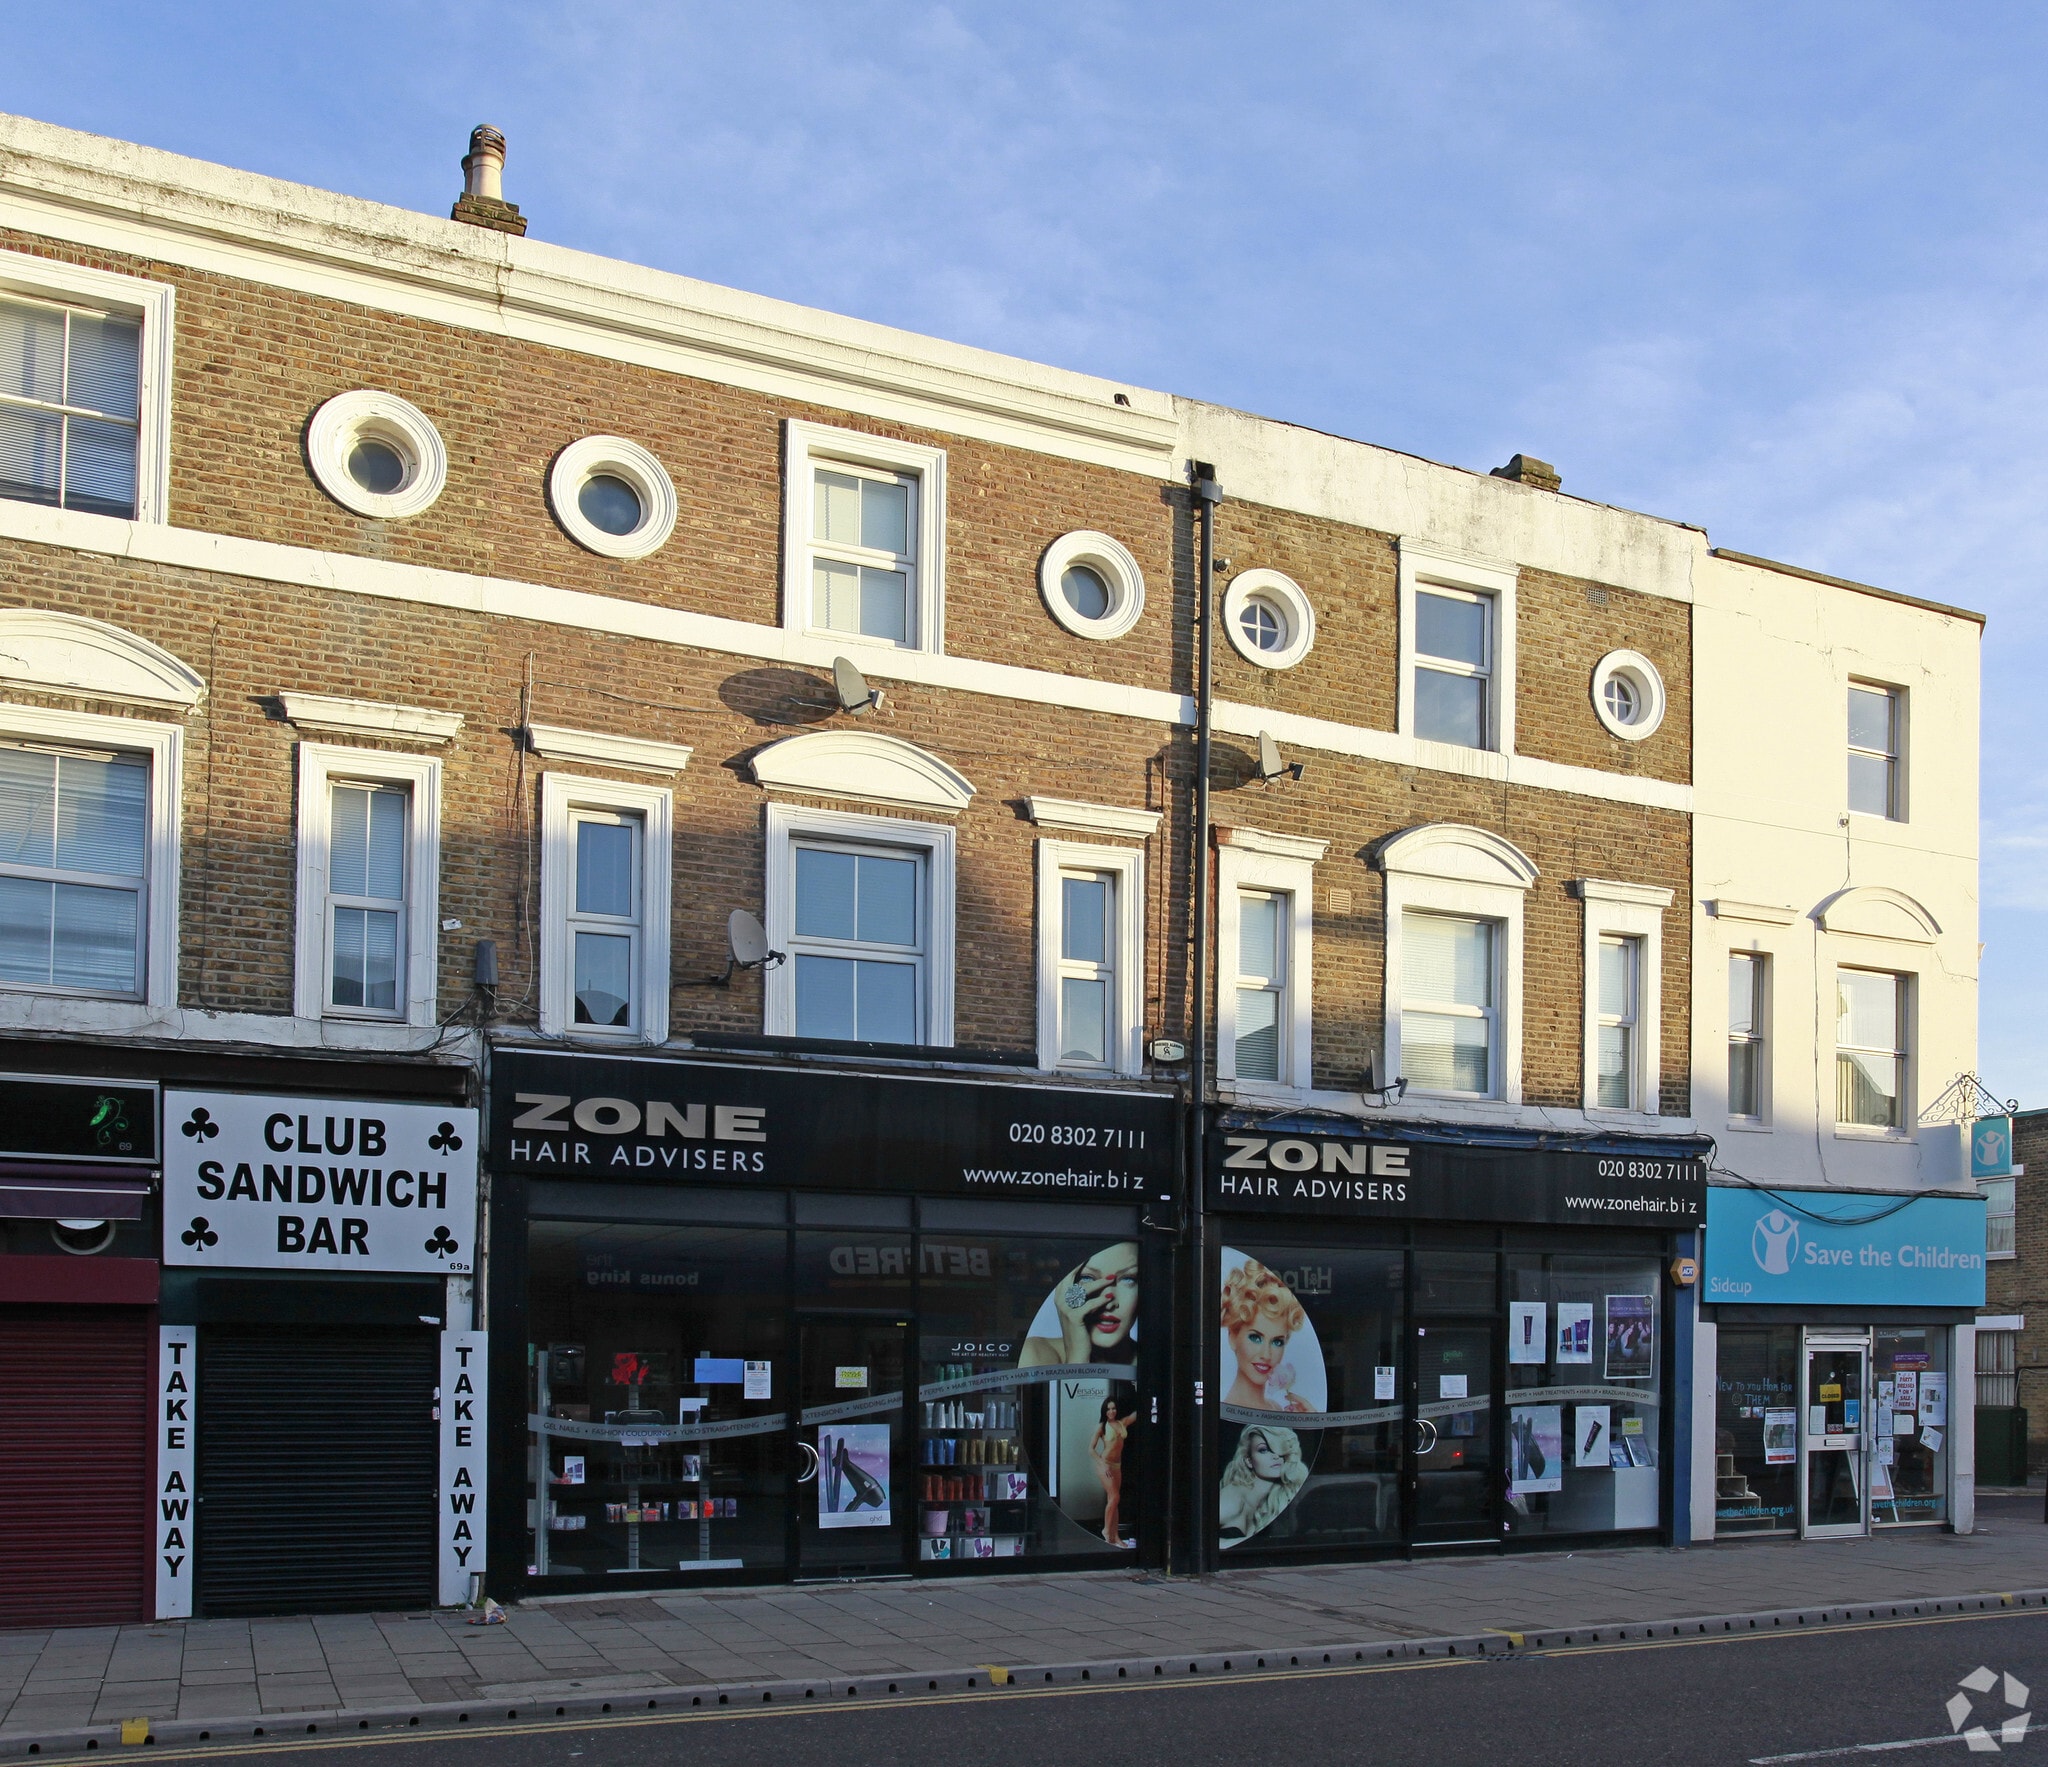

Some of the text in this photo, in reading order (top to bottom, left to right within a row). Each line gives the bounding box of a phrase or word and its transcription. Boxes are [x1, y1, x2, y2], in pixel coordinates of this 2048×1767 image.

[512, 1093, 767, 1142] ZONE
[119, 1142, 132, 1151] 69
[264, 1113, 387, 1156] CLUB
[1009, 1123, 1145, 1149] 020 8302 7111
[511, 1139, 766, 1173] HAIR ADVISERS
[1222, 1136, 1411, 1176] ZONE
[962, 1168, 1144, 1190] www.zonehair.biz
[1599, 1160, 1698, 1181] 020 8302 7111
[197, 1161, 447, 1209] SANDWICH
[1221, 1175, 1408, 1202] HAIR ADVISERS
[1564, 1193, 1698, 1214] www.zonehair.biz
[278, 1216, 370, 1256] BAR
[449, 1262, 470, 1271] 69a
[1804, 1241, 1982, 1270] Save the Children
[1711, 1276, 1753, 1298] Sidcup
[951, 1342, 1010, 1352] JOICO
[924, 1386, 945, 1395] PERMS
[951, 1381, 967, 1390] HAIR
[968, 1375, 1009, 1387] TREATMENTS
[1014, 1371, 1030, 1379] HAIR
[1031, 1370, 1040, 1378] UP
[1045, 1368, 1077, 1376] BRAZILIAN
[165, 1343, 187, 1449] TAKE
[453, 1347, 473, 1446] TAKE
[852, 1398, 887, 1410] WEDDING
[1225, 1407, 1236, 1415] GEL
[1261, 1413, 1286, 1421] FASHION
[1286, 1415, 1320, 1423] COLOURING
[1342, 1411, 1385, 1421] STRAIGHTENING
[543, 1422, 557, 1431] GEL
[559, 1424, 581, 1433] NAILS
[591, 1428, 625, 1436] FASHION
[626, 1429, 671, 1437] COLOURING
[702, 1422, 760, 1434] STRAIGHTENING
[161, 1471, 189, 1577] AWAY
[450, 1468, 475, 1566] AWAY
[869, 1514, 883, 1524] ghd
